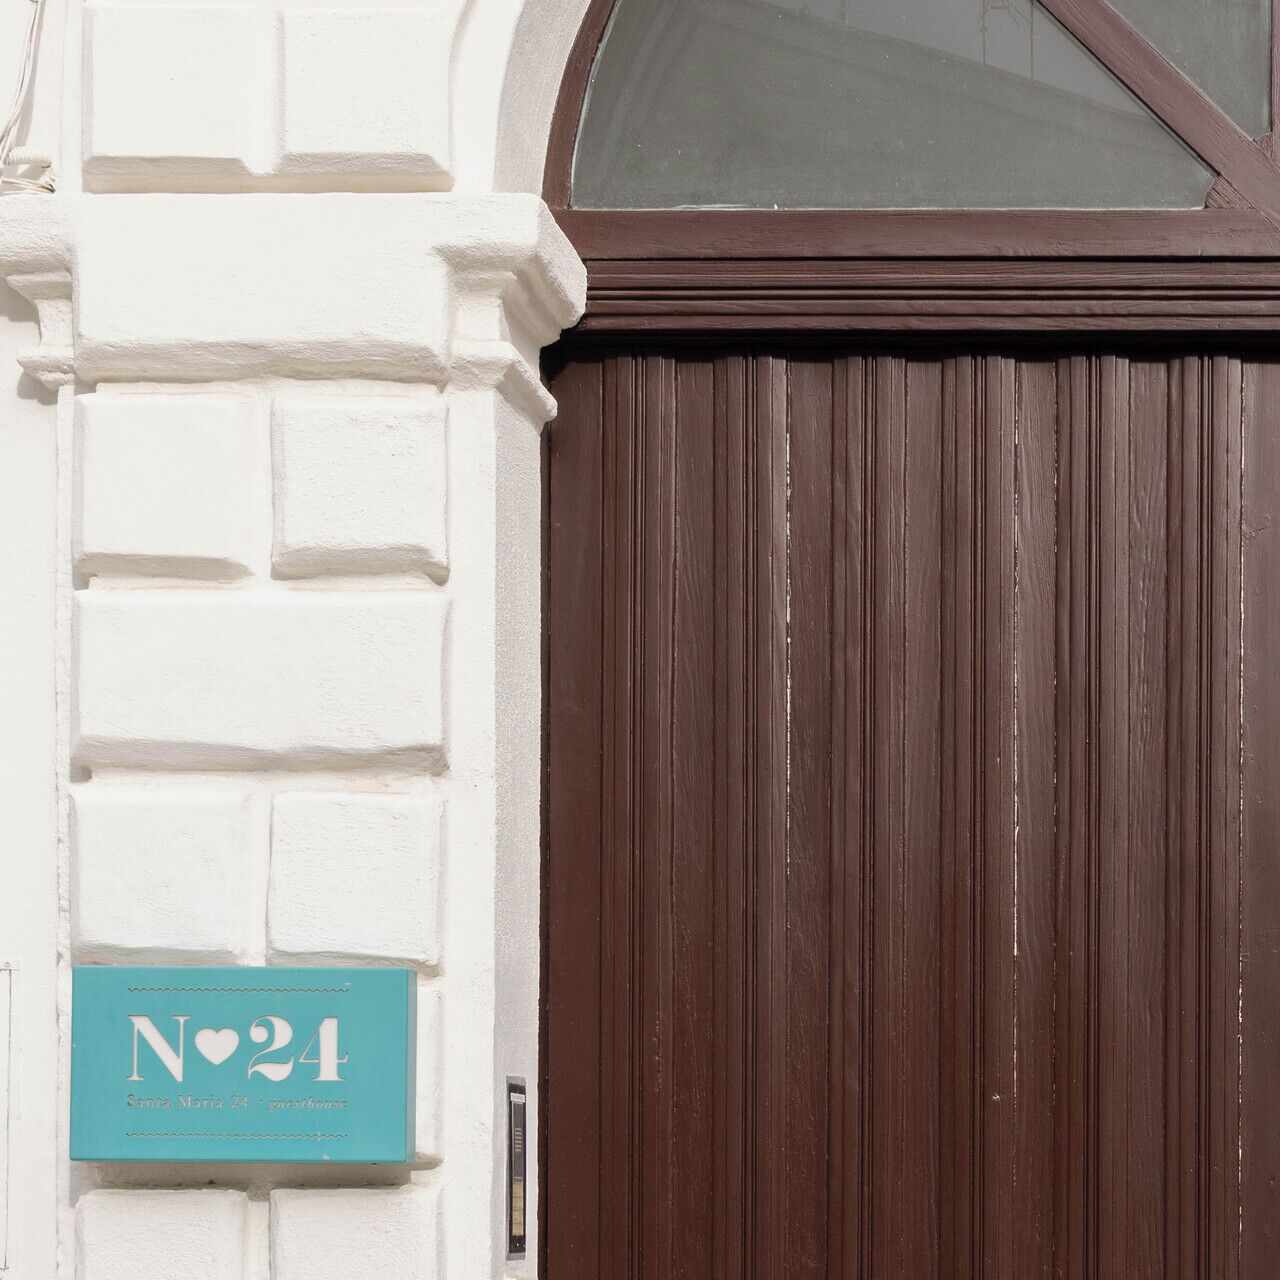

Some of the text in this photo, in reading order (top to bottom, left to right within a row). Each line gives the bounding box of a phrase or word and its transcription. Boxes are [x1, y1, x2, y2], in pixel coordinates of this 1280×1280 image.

[126, 1093, 349, 1112] Santa Maria 24 guesthouse
